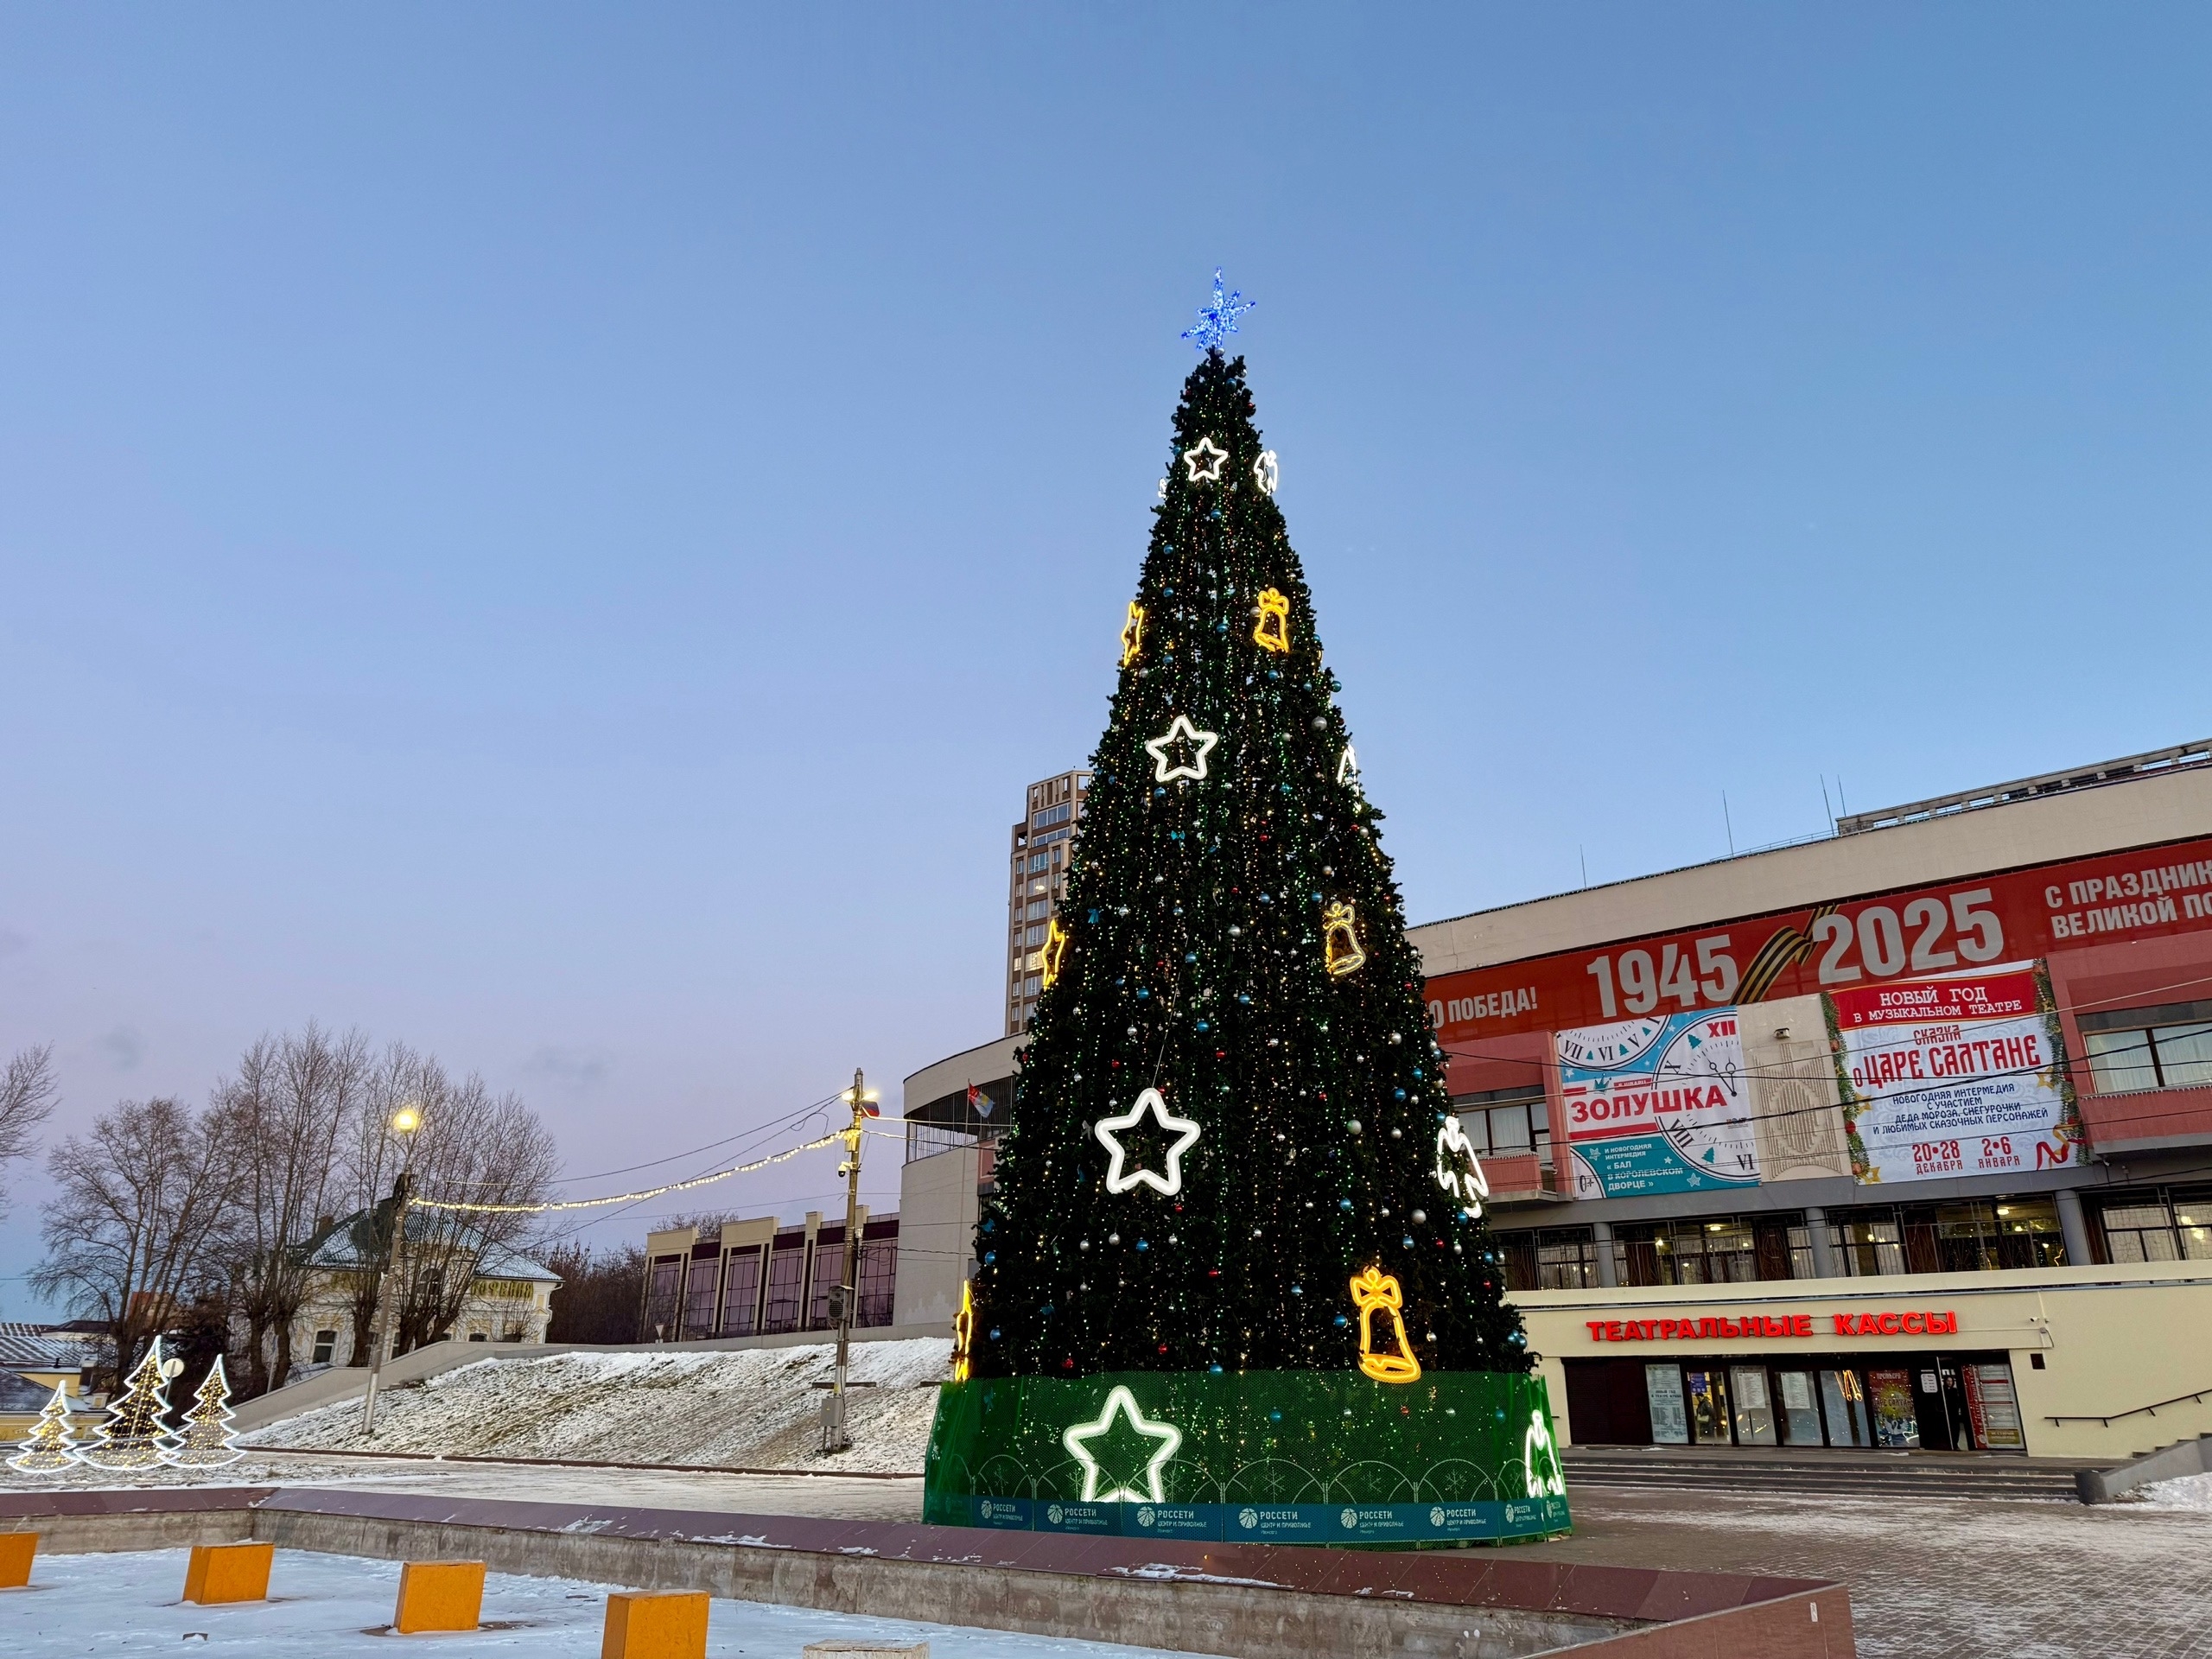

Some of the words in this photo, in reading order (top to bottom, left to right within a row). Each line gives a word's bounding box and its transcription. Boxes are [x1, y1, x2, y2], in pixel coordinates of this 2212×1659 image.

[2044, 885, 2063, 909] С
[2069, 859, 2212, 905] ПРАЗДНИК
[2050, 895, 2177, 939] ВЕЛИКОЙ
[1813, 887, 2005, 985] 2025
[1586, 934, 1740, 1018] 1945
[1447, 986, 1538, 1023] ПОБЕДА!
[1879, 986, 1940, 1007] НОВЫЙ
[1948, 986, 1988, 1003] ГОД
[1853, 1013, 1862, 1023] В
[1868, 1005, 1962, 1020] МУЗЫКАЛЬНОМ
[1968, 1000, 2023, 1015] ТЕАТРЕ
[1912, 1024, 1962, 1046] СКАЗКА
[1863, 1046, 1923, 1089] ЦАРЕ
[1929, 1034, 2042, 1077] САЛТАНЕ
[1570, 1084, 1728, 1123] ЗОЛУШКА
[1892, 1090, 1952, 1105] НОВОГОДНЯЯ
[1954, 1083, 2015, 1098] ИНТЕРМЕДИЯ
[1926, 1102, 1934, 1110] С
[1935, 1096, 1983, 1109] УЧАСТИЕМ
[1872, 1126, 1880, 1135] И
[1882, 1122, 1928, 1135] ЛЮБИМЫХ
[1929, 1116, 1984, 1130] СКАЗОЧНЫХ
[1986, 1108, 2049, 1125] ПЕРСОНАЖЕЙ
[1895, 1113, 1919, 1124] ДЕДА
[1962, 1102, 2021, 1116] СНЕГУРОЧКИ
[1605, 1150, 1647, 1160] ИНТЕРМЕДИЯ
[1610, 1143, 1652, 1153] НОВОГОДНЯЯ
[1614, 1166, 1684, 1180] КОРОЛЕВСКОМ
[1916, 1159, 1963, 1175] ДЕКАБРЯ
[1978, 1155, 2020, 1169] ЯНВАРЯ
[1608, 1180, 1646, 1192] ДВОРЦЕ
[1586, 1314, 1814, 1342] ТЕАТРАЛЬНЫЕ
[1833, 1310, 1958, 1336] КАССЫ
[1065, 1508, 1096, 1517] РОССЕТИ
[1157, 1510, 1194, 1519] РОССЕТИ
[1260, 1511, 1298, 1520] РОССЕТИ
[1359, 1510, 1393, 1520] РОССЕТИ
[1446, 1509, 1477, 1517] РОССЕТИ
